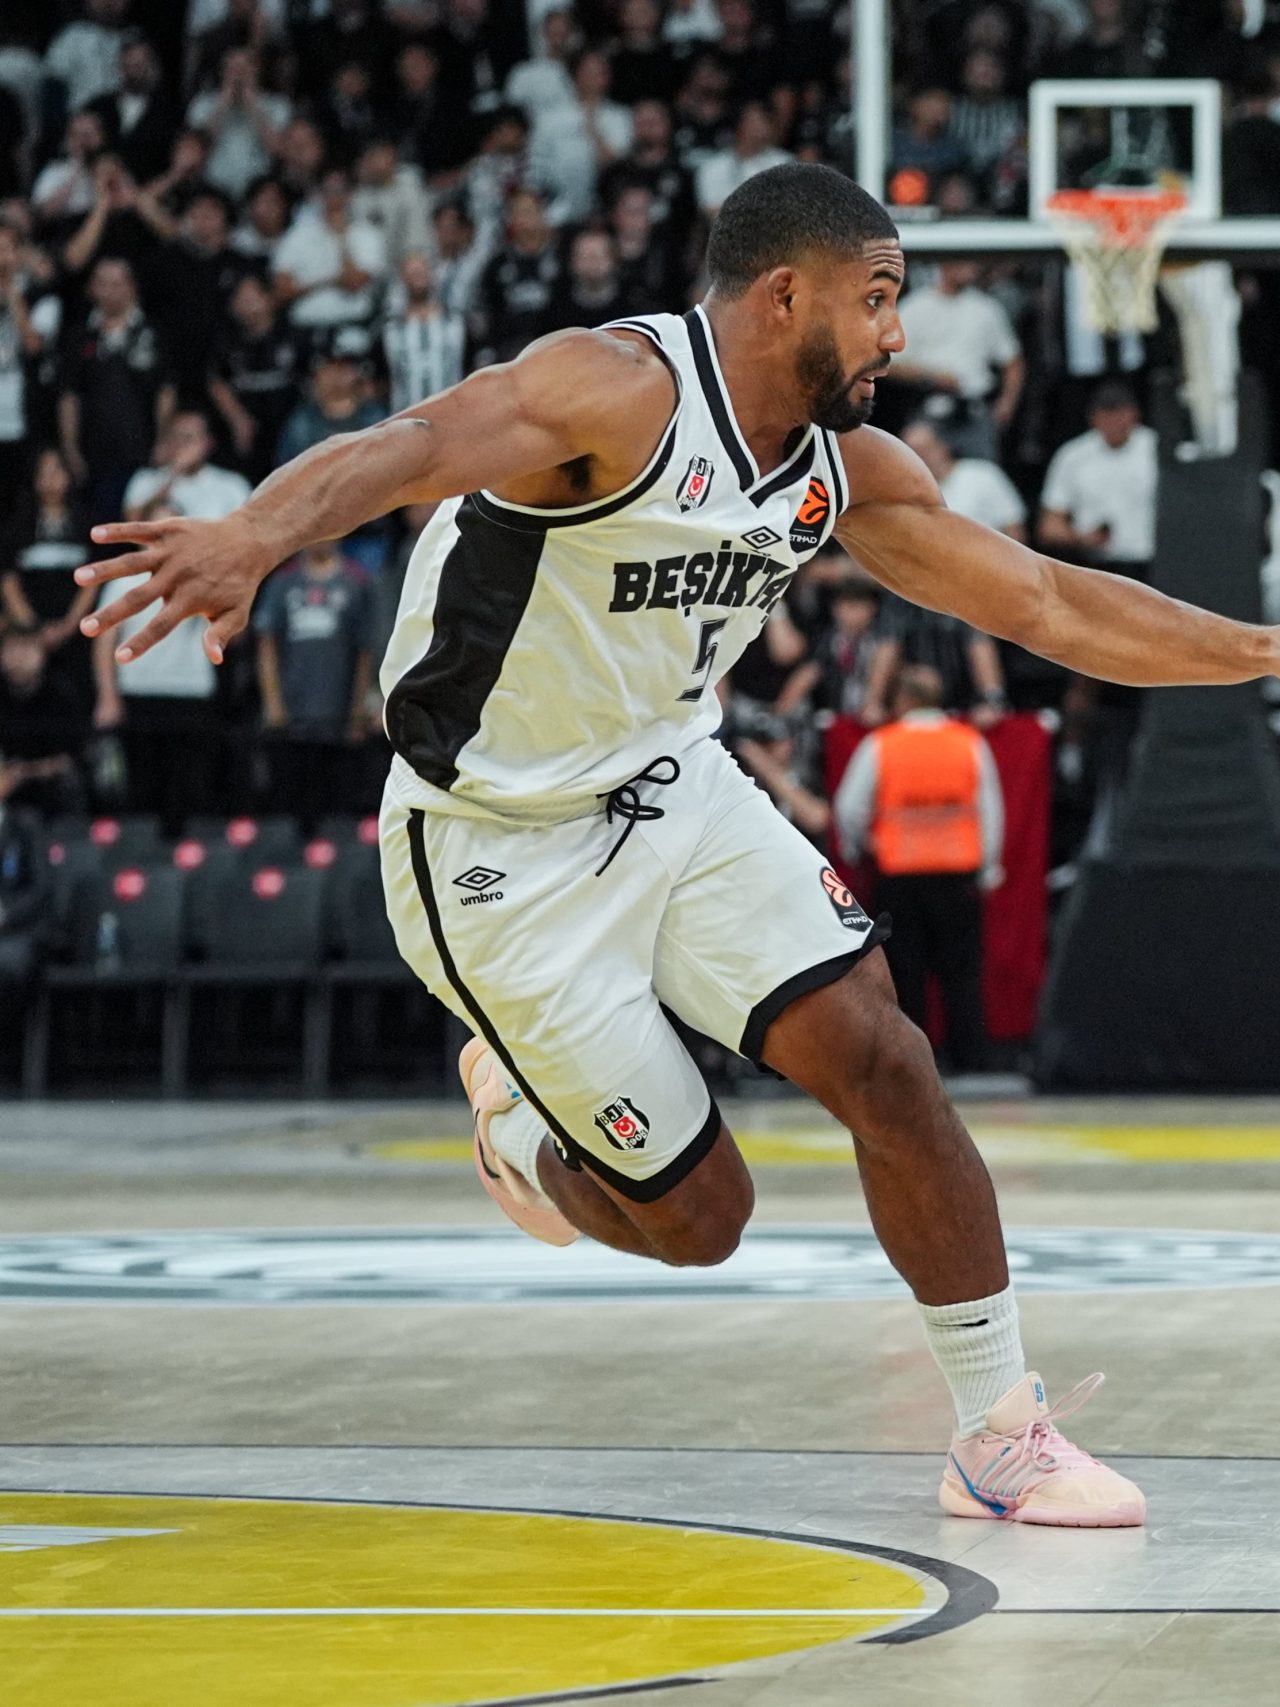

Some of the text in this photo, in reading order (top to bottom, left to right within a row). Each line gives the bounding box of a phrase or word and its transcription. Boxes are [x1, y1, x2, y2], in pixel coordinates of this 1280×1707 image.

[608, 540, 794, 624] BEŞİKTA
[460, 891, 504, 906] umbro
[599, 1101, 628, 1126] BJK
